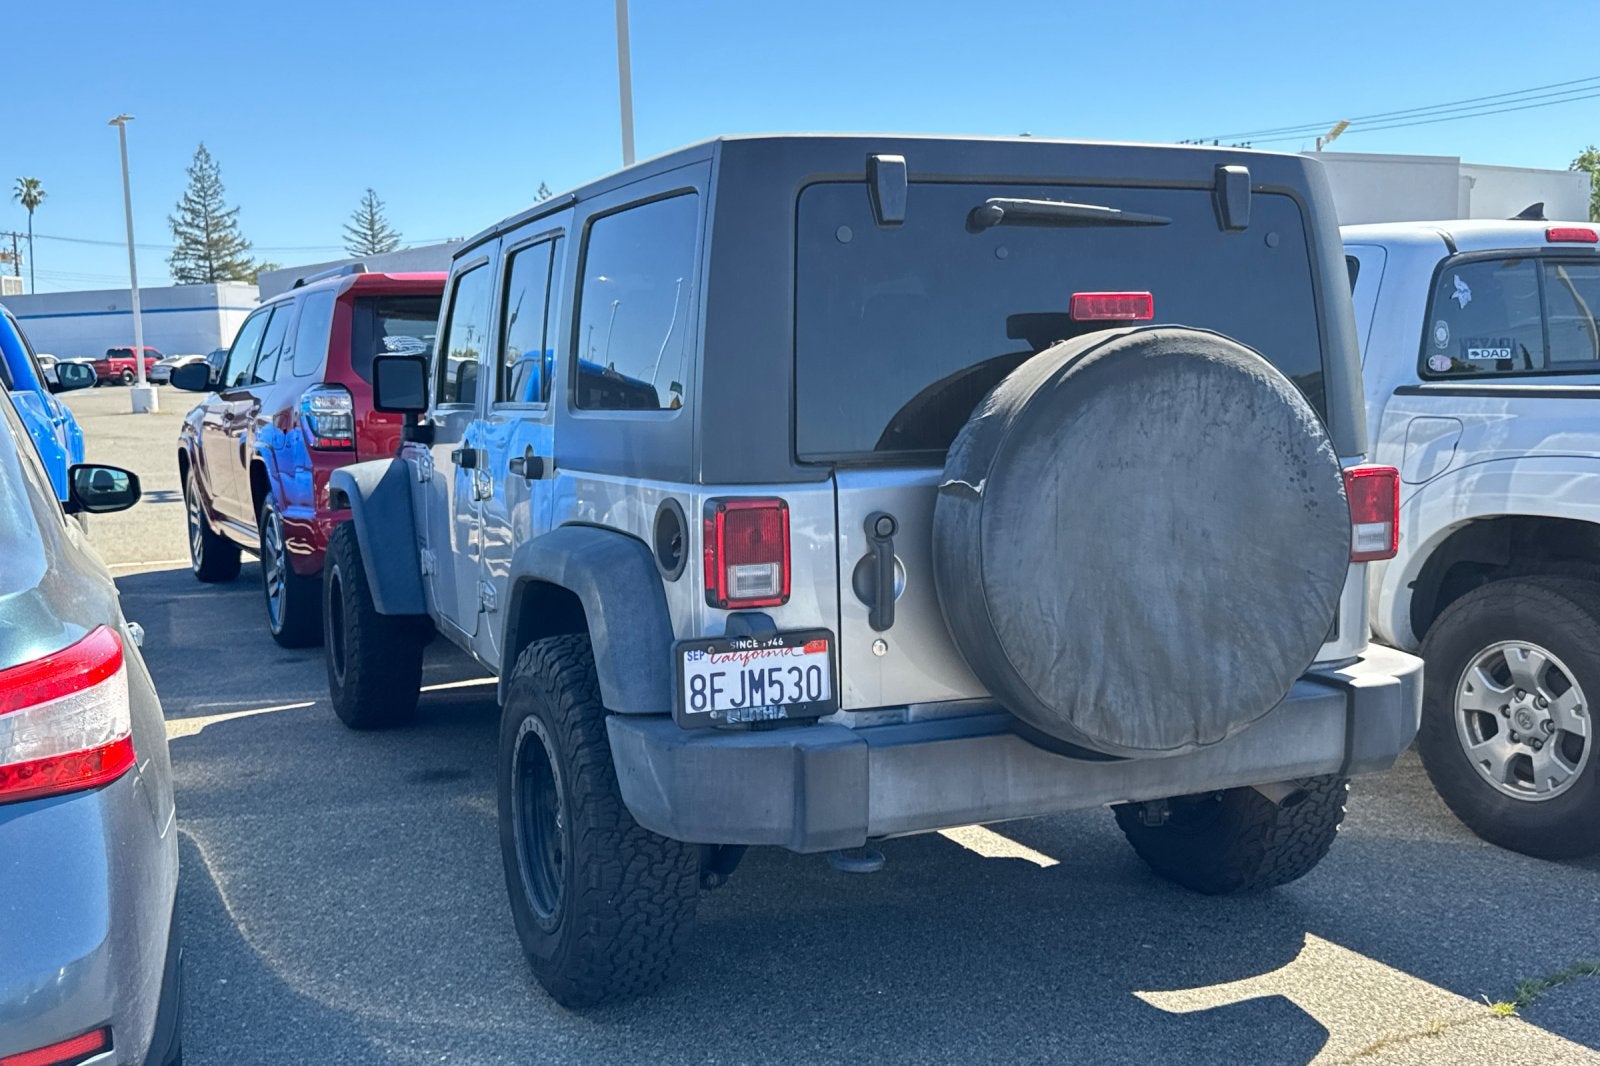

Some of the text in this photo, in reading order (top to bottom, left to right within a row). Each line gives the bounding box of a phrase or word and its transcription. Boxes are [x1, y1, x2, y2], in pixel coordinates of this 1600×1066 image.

[1481, 349, 1508, 358] DAD
[730, 639, 758, 649] SINCE
[687, 650, 705, 662] SEP
[689, 664, 822, 712] 8FJM530
